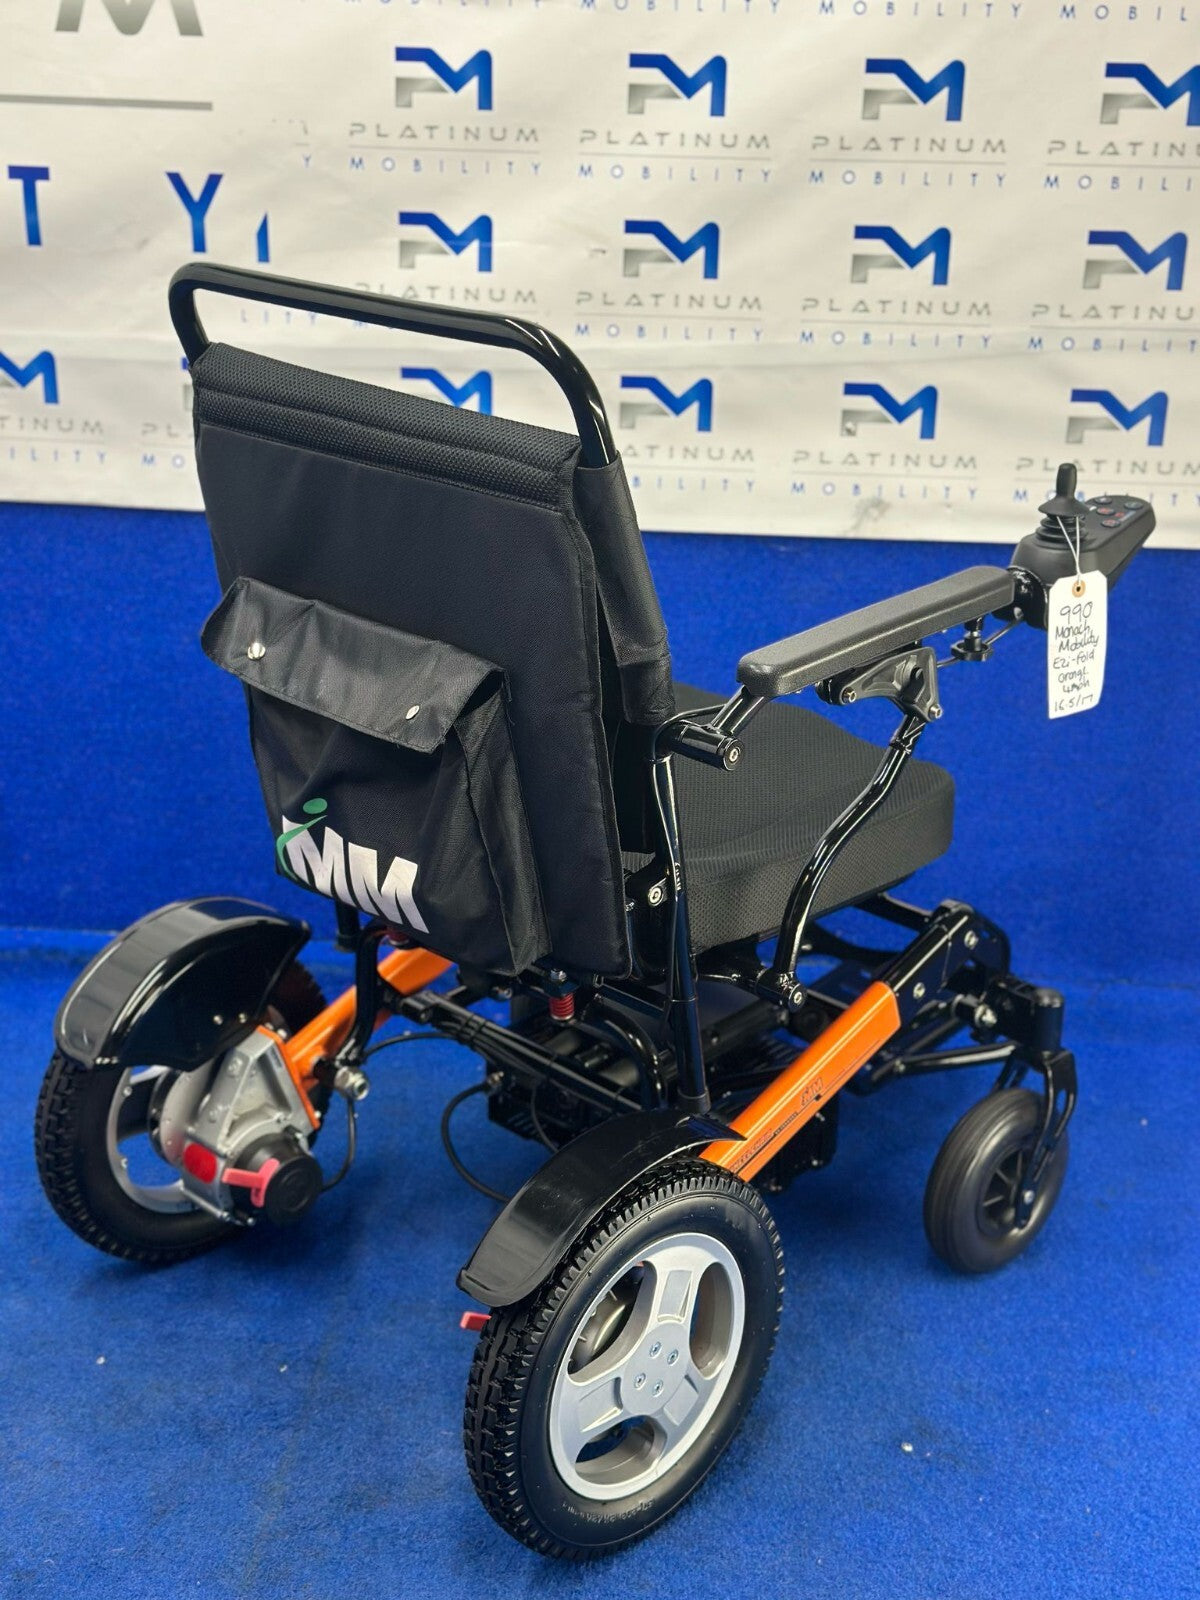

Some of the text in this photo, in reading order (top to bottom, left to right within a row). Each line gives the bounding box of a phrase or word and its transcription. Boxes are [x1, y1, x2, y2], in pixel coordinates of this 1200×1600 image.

[819, 1, 1022, 18] MOBILITY
[349, 122, 539, 142] PLATINUM
[579, 129, 770, 149] PLATINUM
[811, 135, 1007, 153] PLATINUM
[1048, 140, 1200, 157] PLATIN
[349, 156, 541, 175] MOBILITY
[578, 163, 771, 182] MOBILITY
[809, 169, 1006, 187] MOBILITY
[575, 291, 762, 310] PLATINUM
[801, 297, 992, 316] PLATINUM
[575, 323, 763, 341] MOBILITY
[800, 330, 991, 348] MOBILITY
[793, 450, 978, 470] PLATINUM
[791, 481, 978, 500] MOBILITY
[1060, 601, 1093, 625] 990
